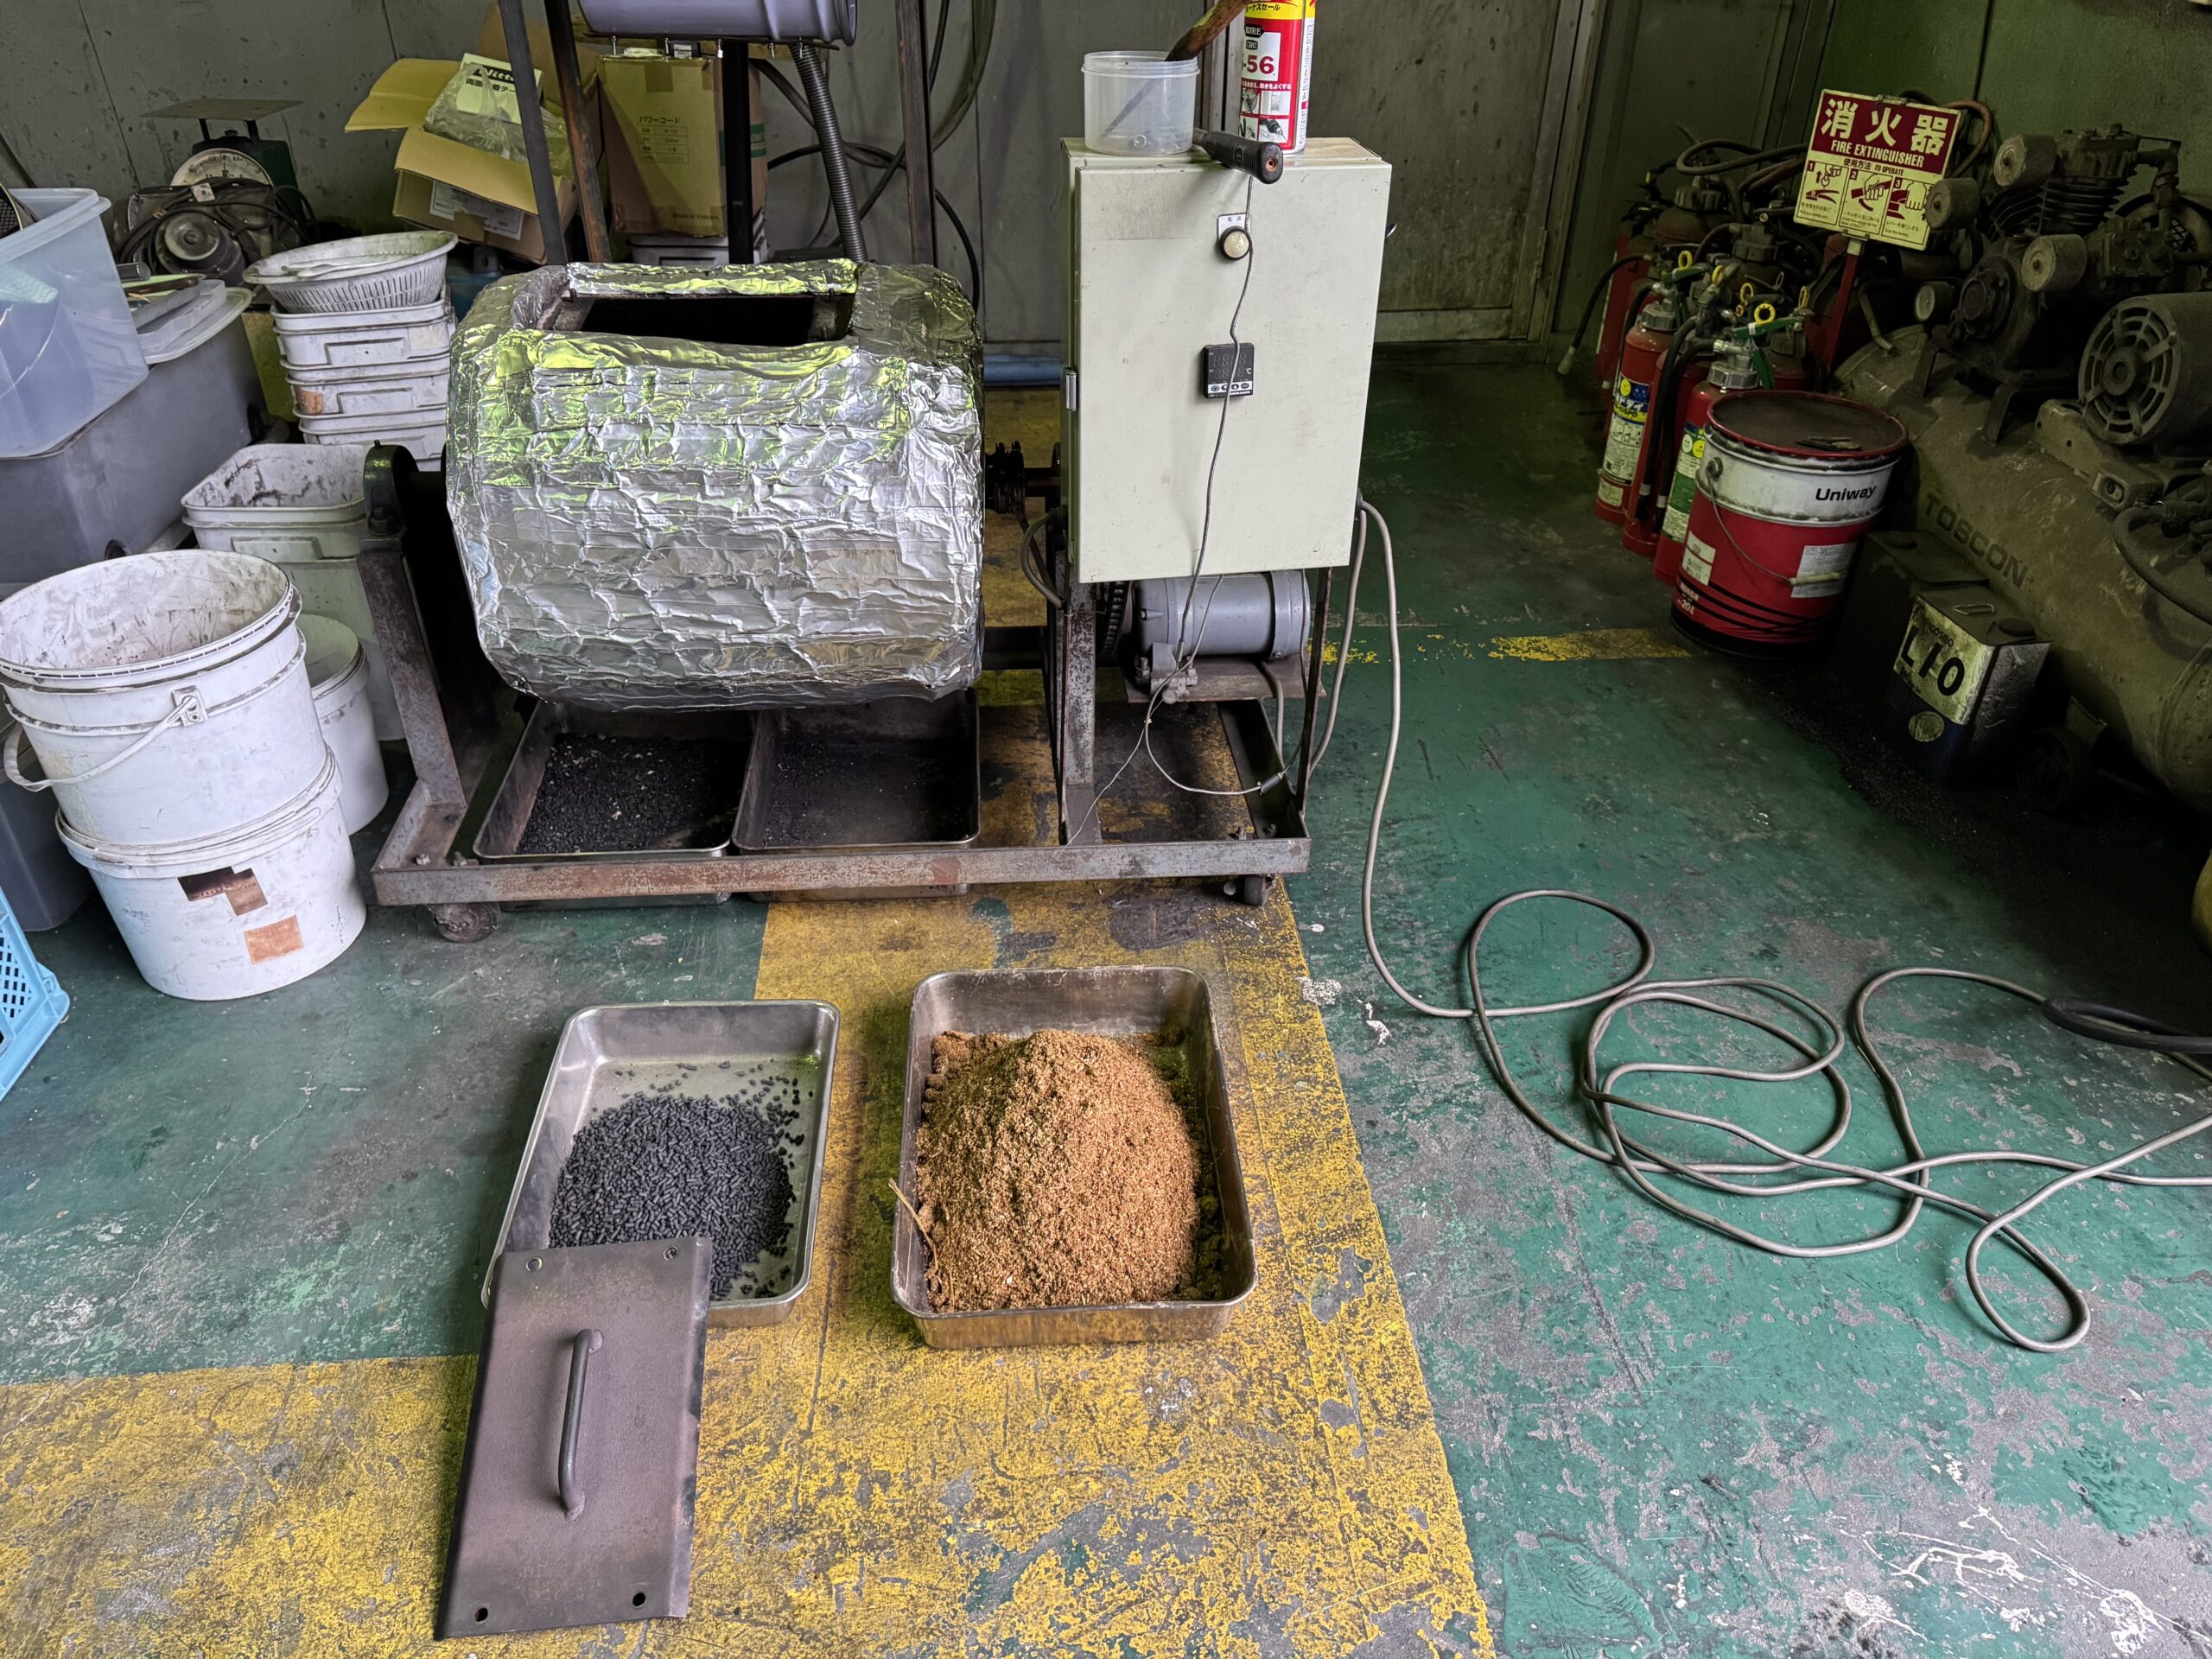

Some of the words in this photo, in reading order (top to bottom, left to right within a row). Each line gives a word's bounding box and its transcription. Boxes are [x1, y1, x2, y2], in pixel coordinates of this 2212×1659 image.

[477, 68, 514, 81] Nitt
[639, 116, 681, 124] パワーコード
[1821, 98, 1948, 156] 消火器
[1831, 139, 1853, 154] FIRE
[1854, 143, 1925, 168] EXTINGUISHER
[1843, 157, 1872, 170] 使用方法
[1882, 165, 1904, 176] OPERATE
[1851, 170, 1857, 179] 2
[1815, 486, 1877, 501] Uniway
[1925, 492, 2029, 588] TOSCON
[1929, 624, 1955, 648] COSMO
